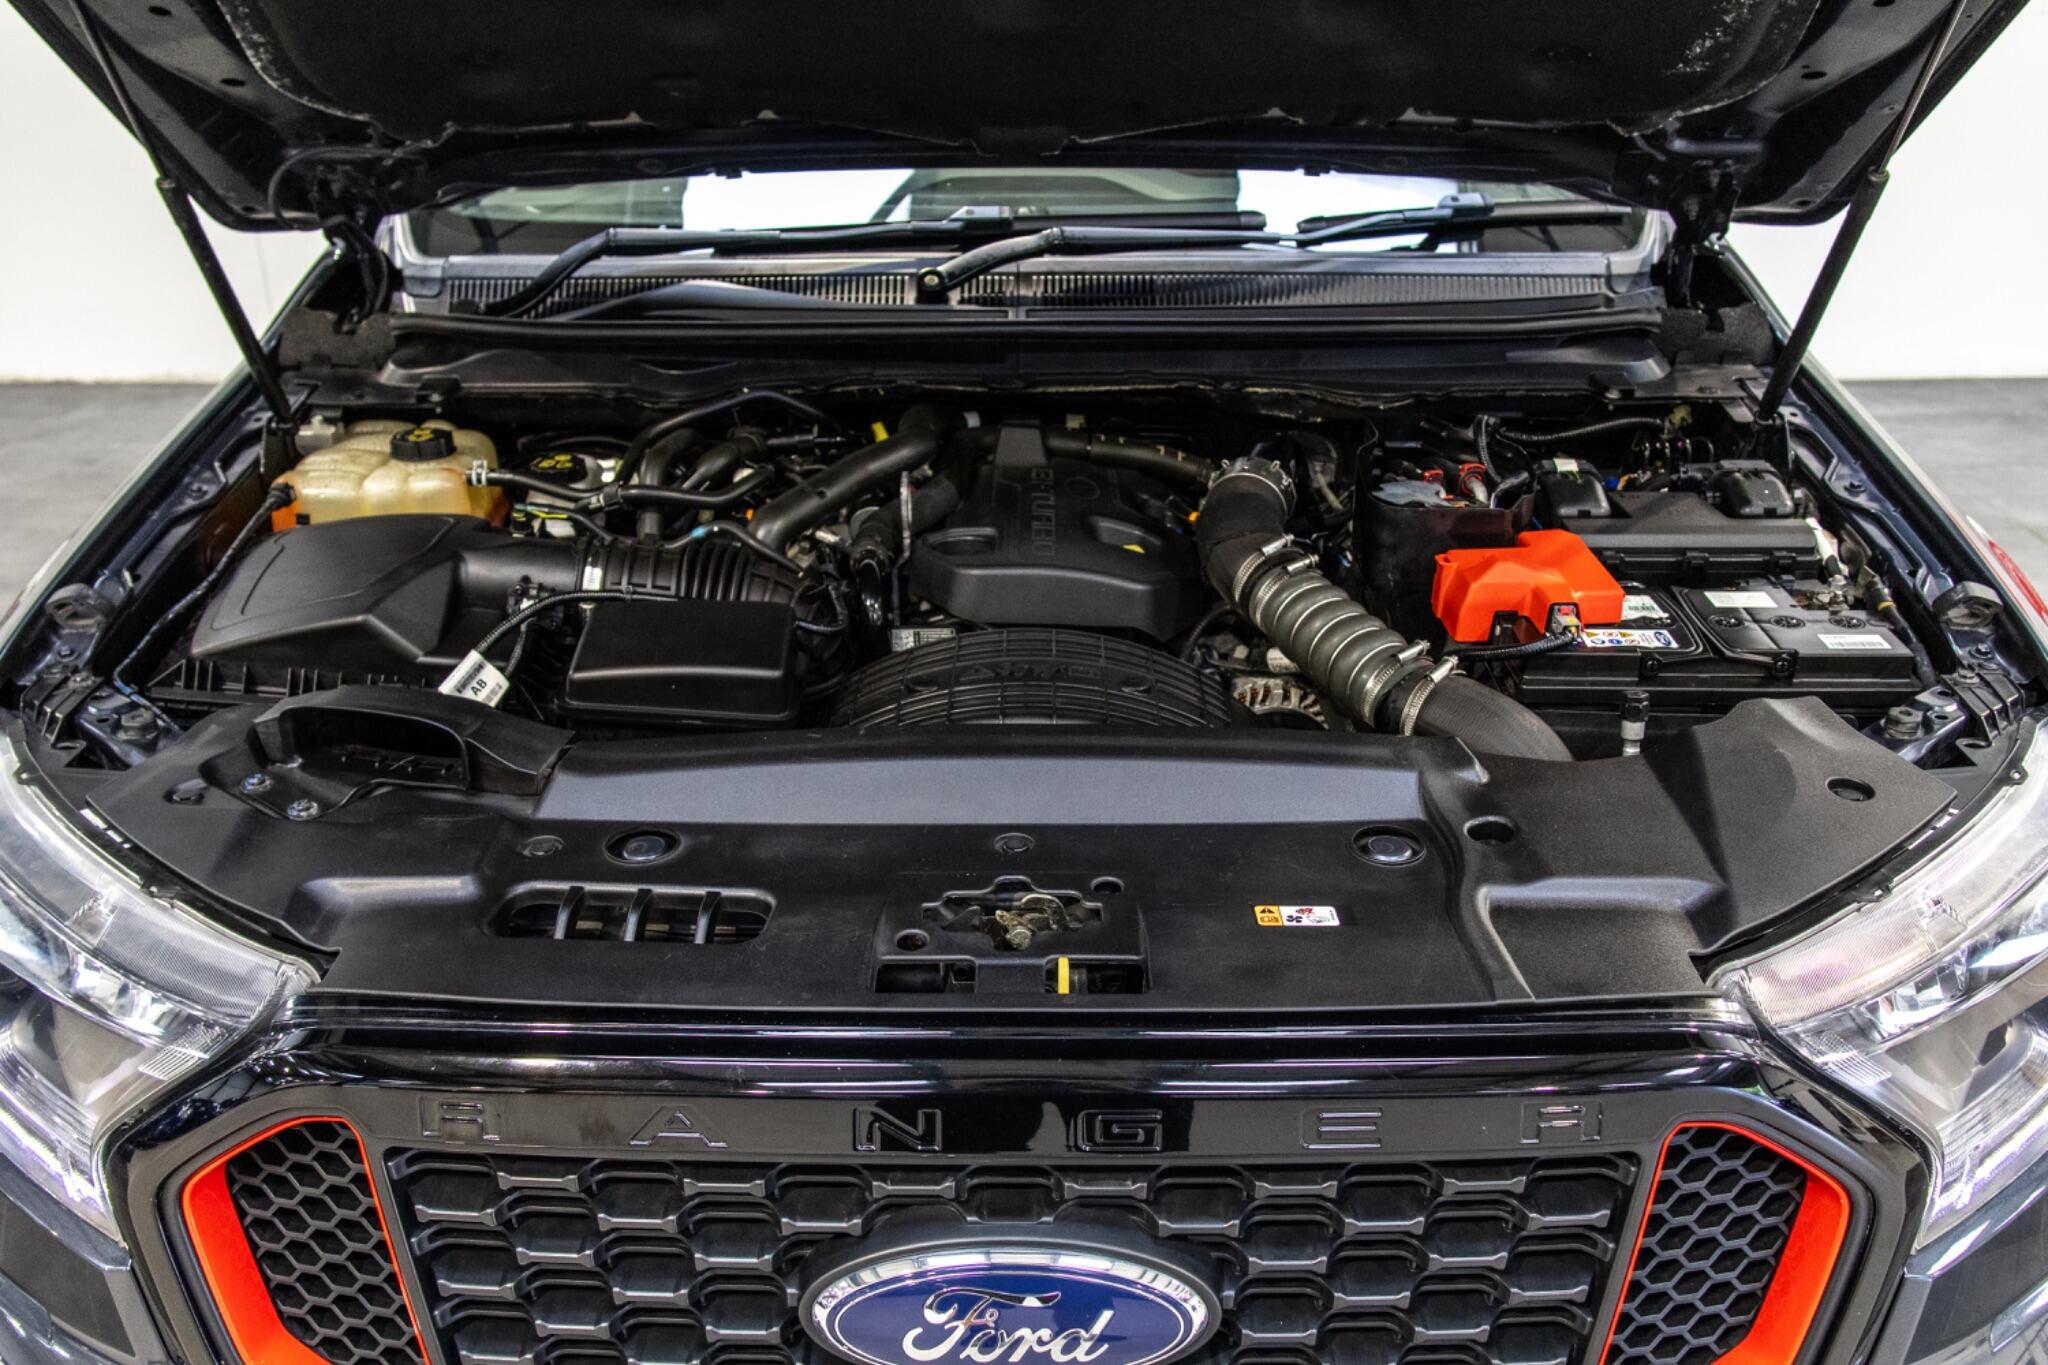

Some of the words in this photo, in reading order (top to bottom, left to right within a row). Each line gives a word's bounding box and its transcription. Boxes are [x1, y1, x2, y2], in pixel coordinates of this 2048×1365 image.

[470, 679, 487, 696] AB
[418, 1096, 1603, 1153] RANGER
[902, 1286, 1115, 1362] Ford
